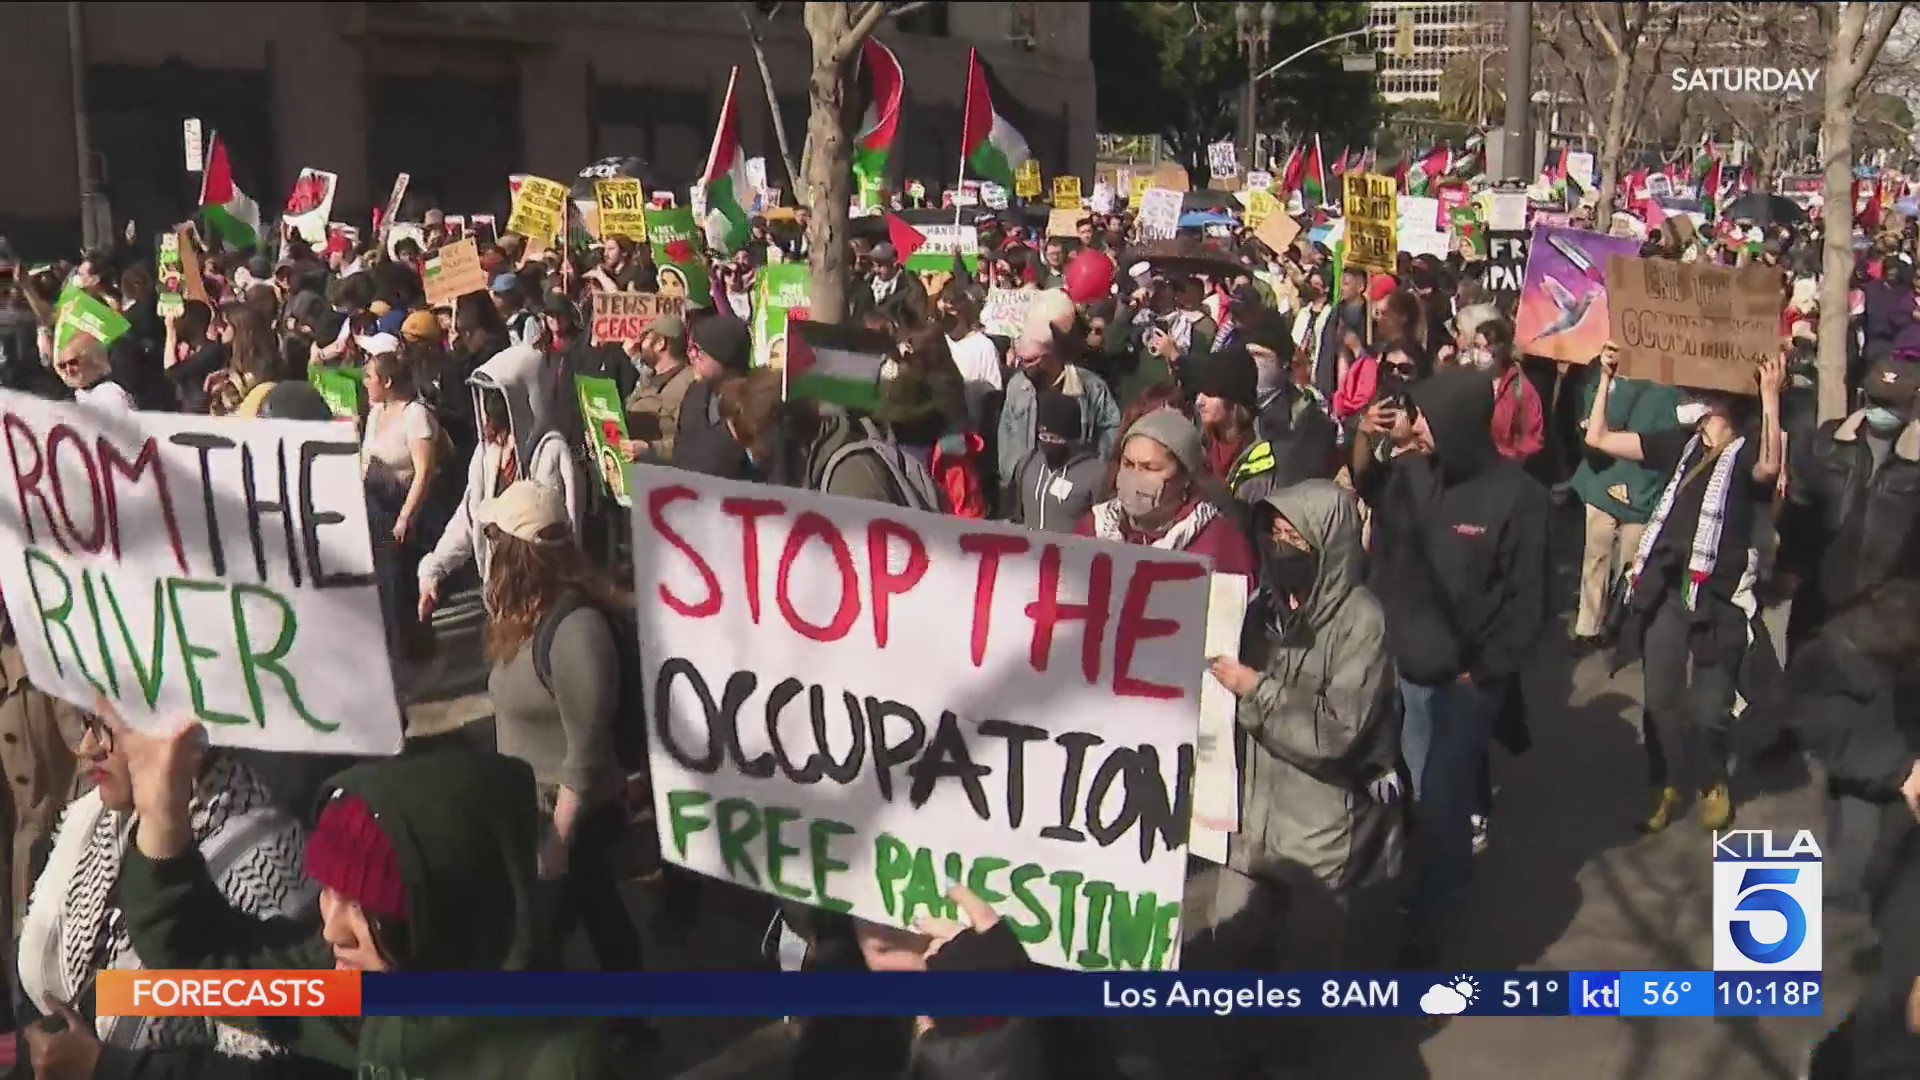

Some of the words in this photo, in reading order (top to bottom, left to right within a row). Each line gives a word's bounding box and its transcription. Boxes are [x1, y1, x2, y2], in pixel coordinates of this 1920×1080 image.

[601, 193, 614, 209] IS
[616, 192, 638, 209] NOT
[1212, 164, 1235, 177] NOW
[596, 295, 650, 315] JEWS
[655, 296, 684, 316] FOR
[3, 412, 190, 575] ROM
[170, 432, 379, 588] THE
[25, 547, 341, 732] RIVER
[648, 485, 930, 648] STOP
[959, 534, 1207, 699] THE
[655, 657, 1194, 863] OCCUPATION
[667, 790, 857, 912] FREE
